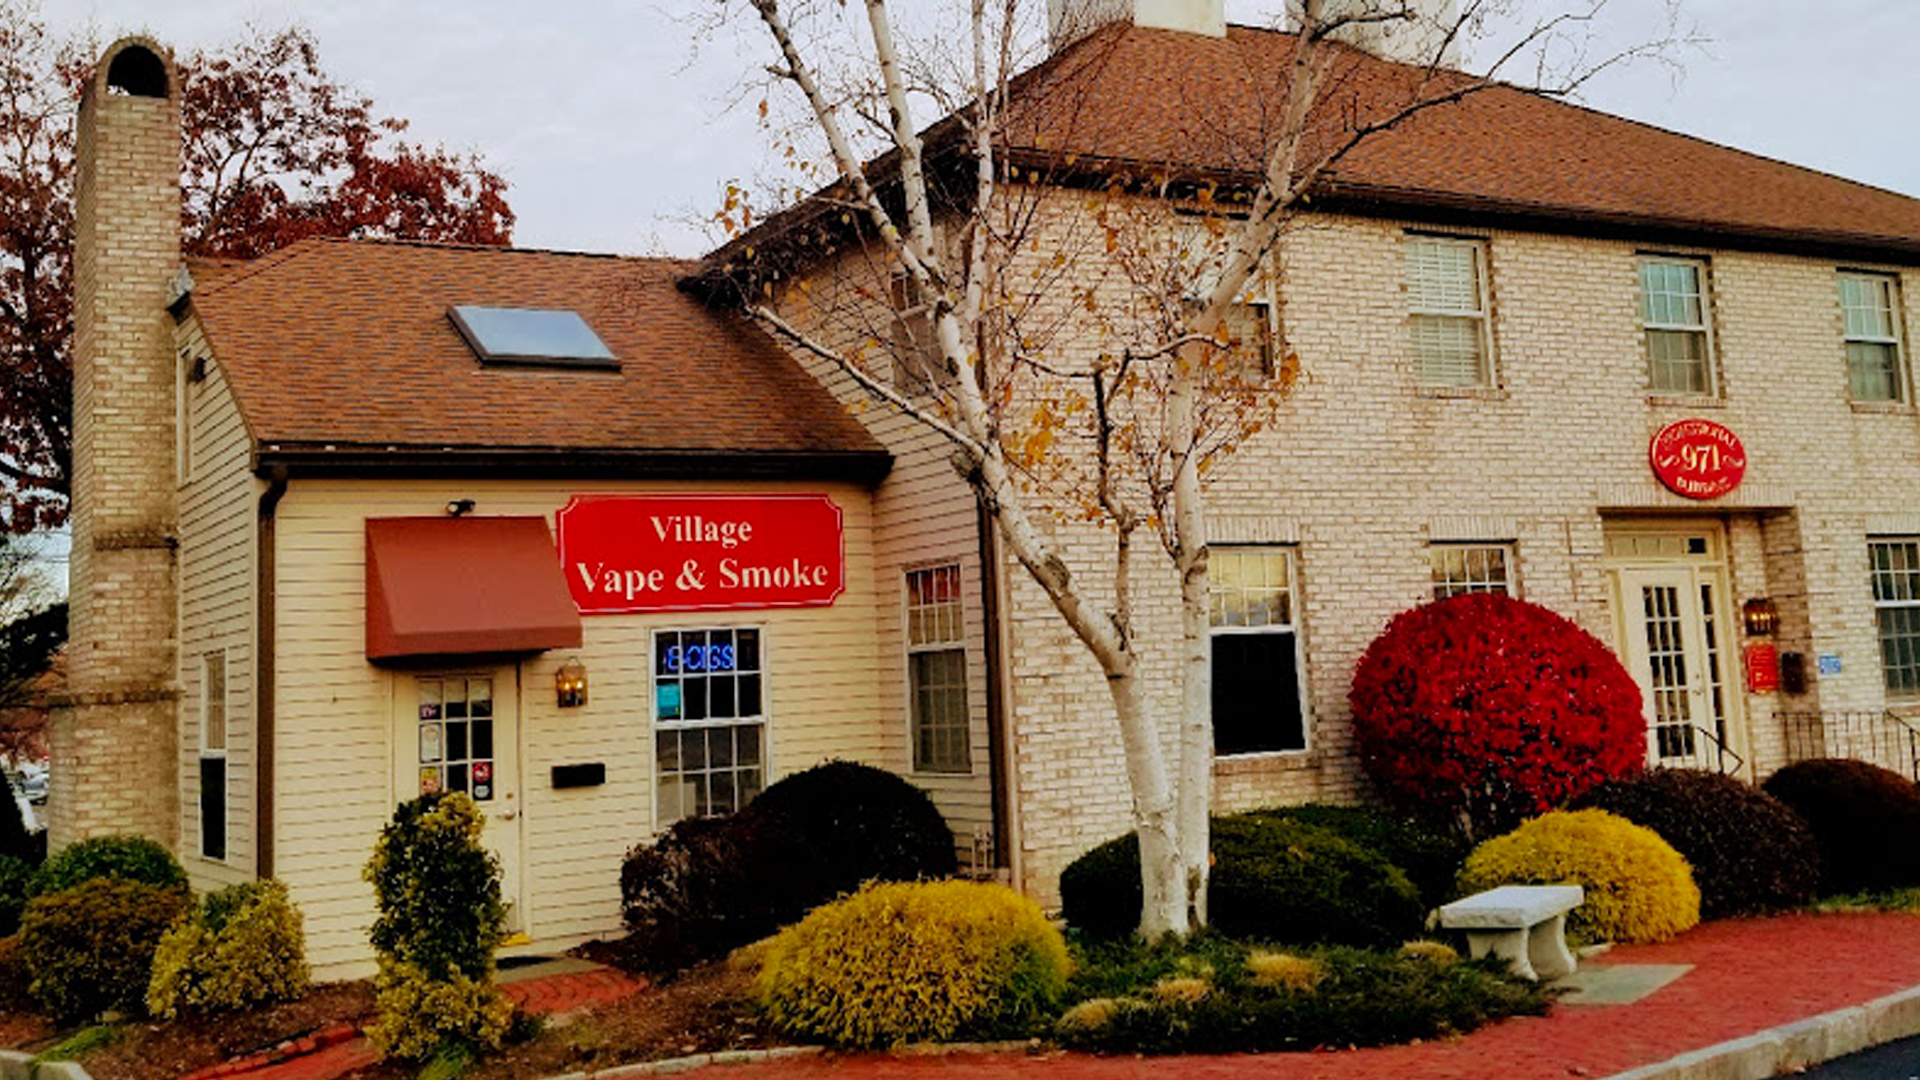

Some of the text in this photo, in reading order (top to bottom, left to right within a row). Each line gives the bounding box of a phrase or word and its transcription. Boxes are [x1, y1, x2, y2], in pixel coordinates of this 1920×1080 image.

[1681, 443, 1721, 473] 971
[650, 516, 752, 548] Village
[577, 558, 828, 600] Vape & Smoke
